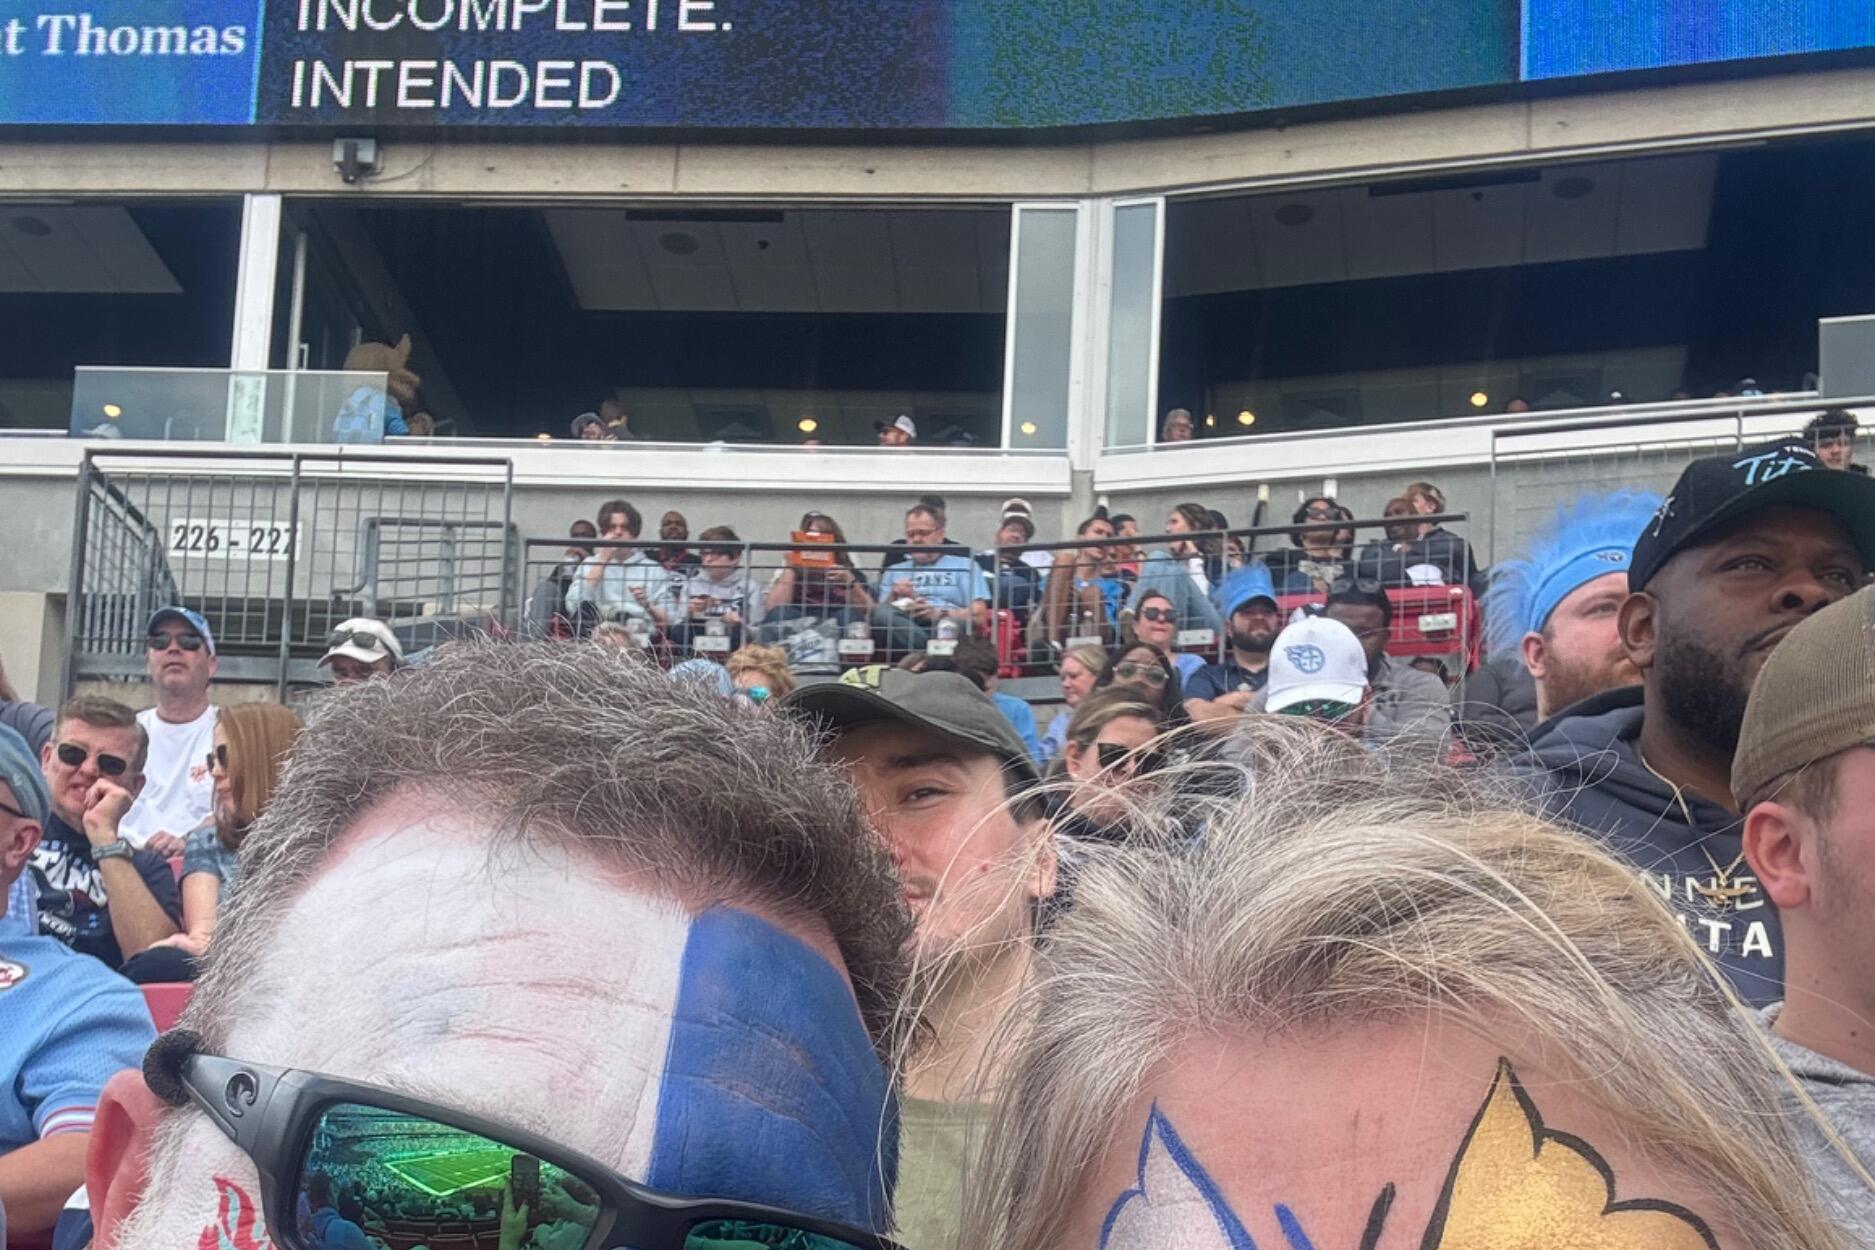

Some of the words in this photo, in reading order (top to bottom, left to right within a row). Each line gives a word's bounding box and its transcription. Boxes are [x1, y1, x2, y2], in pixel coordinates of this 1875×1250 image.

[37, 13, 247, 56] Thomas
[297, 0, 732, 31] INCOMPLETE.
[292, 60, 622, 108] INTENDED
[1732, 450, 1813, 486] Tit
[173, 524, 220, 553] 226
[1676, 914, 1774, 959] TA
